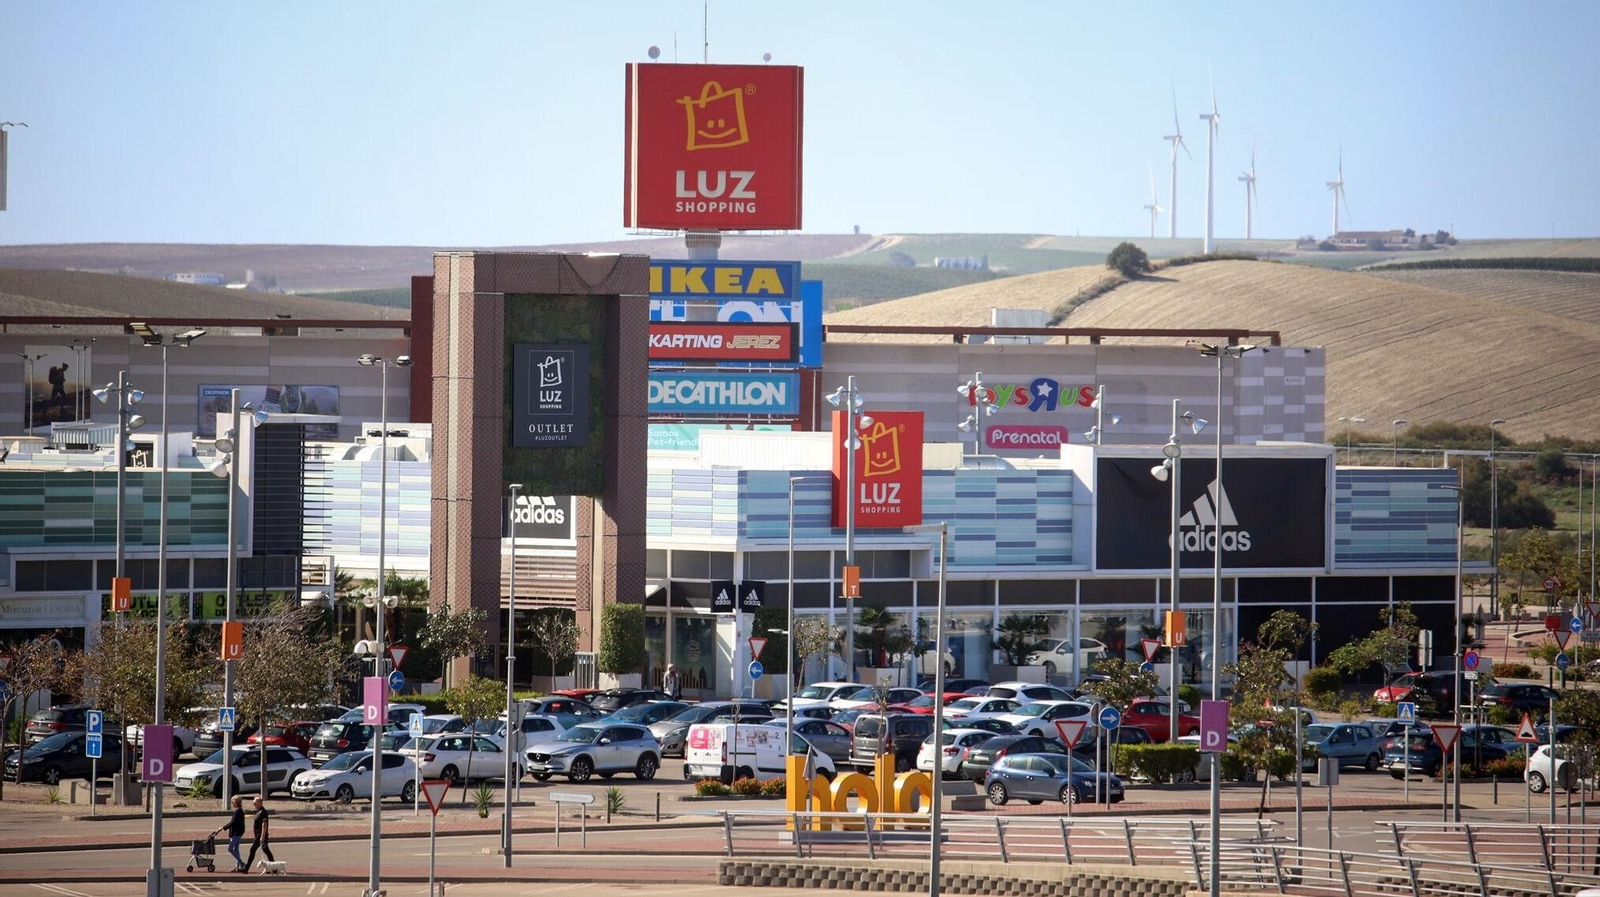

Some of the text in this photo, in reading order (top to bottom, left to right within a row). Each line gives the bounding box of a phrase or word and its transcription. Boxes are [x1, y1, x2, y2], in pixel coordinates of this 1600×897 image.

[676, 170, 756, 198] LUZ
[675, 202, 756, 213] SHOPPING
[650, 266, 785, 294] IKEA
[649, 334, 781, 349] KARTING JEREZ
[539, 390, 562, 402] LUZ
[648, 380, 786, 405] DECATHLON
[528, 424, 574, 433] OUTLET
[648, 429, 679, 437] Somos
[991, 429, 1062, 444] Prénatal
[860, 482, 900, 504] LUZ
[510, 503, 564, 524] adidas
[860, 506, 900, 514] SHOPPING
[850, 585, 857, 595] T
[120, 598, 127, 608] U
[215, 594, 273, 607] OTLET
[1175, 632, 1183, 644] U
[230, 644, 238, 656] U
[368, 705, 378, 719] D
[89, 713, 99, 731] P
[1206, 731, 1220, 746] D
[149, 758, 164, 776] D
